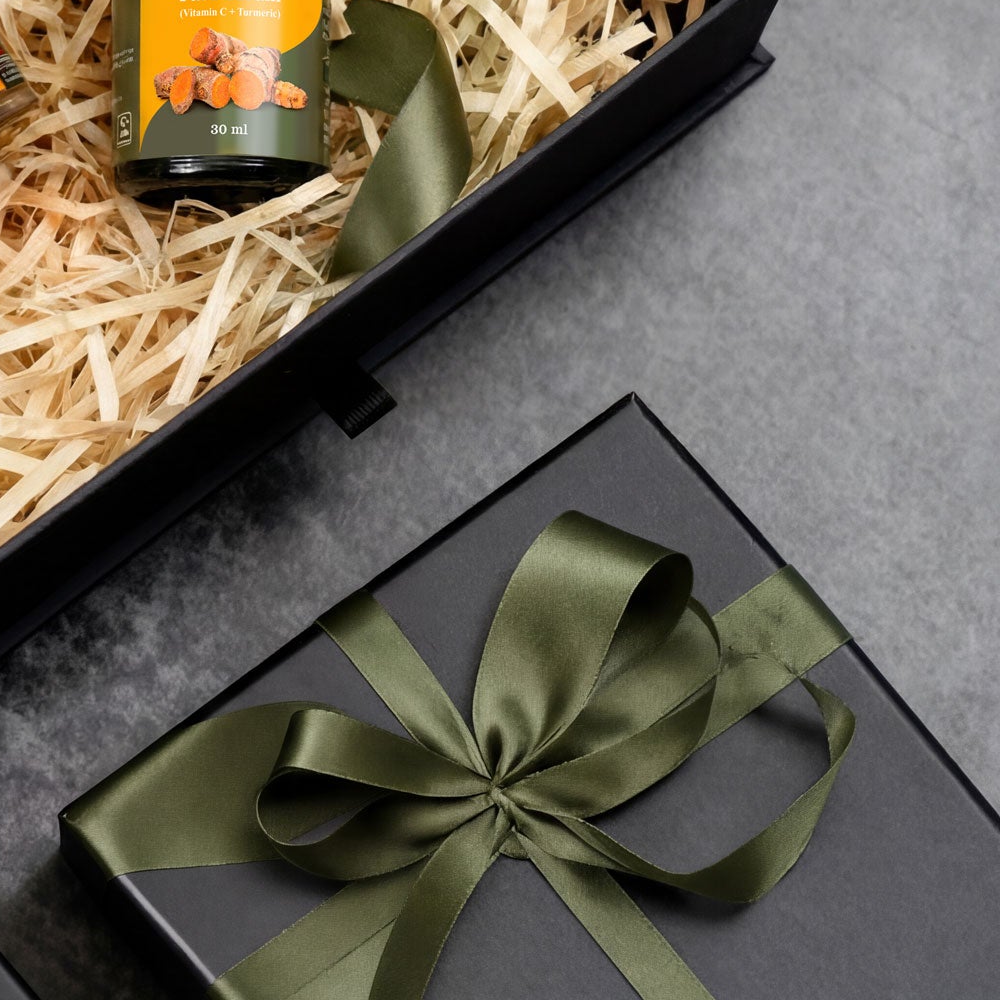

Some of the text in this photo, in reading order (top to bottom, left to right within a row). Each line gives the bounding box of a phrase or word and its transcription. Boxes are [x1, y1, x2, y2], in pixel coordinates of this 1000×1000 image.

[179, 7, 218, 19] (Vitamin
[219, 7, 227, 17] C
[239, 7, 281, 19] Turmeric)
[210, 123, 249, 135] 30 ml
